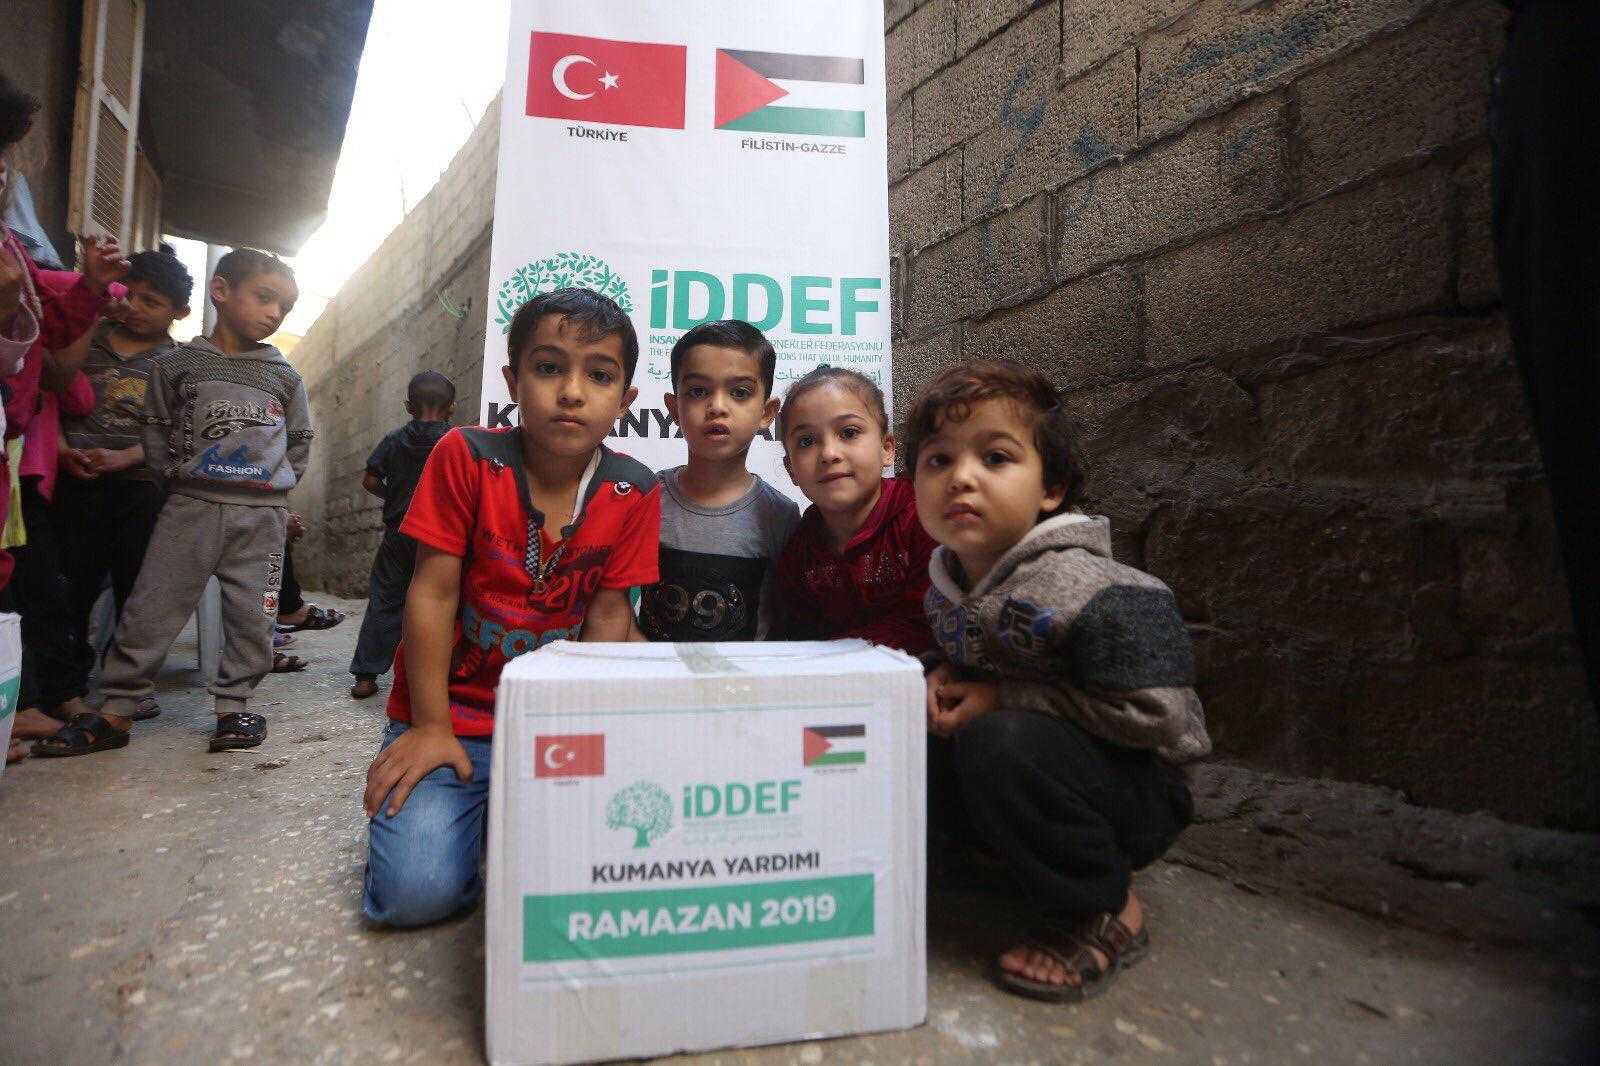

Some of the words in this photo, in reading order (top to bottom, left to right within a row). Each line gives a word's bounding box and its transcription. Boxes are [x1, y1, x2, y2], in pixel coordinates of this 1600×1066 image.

[566, 125, 628, 142] TÜRKİYE
[741, 138, 847, 155] FİLİSTİN-GAZZE
[843, 354, 883, 363] HUMANITY
[207, 463, 263, 476] FASHION
[591, 858, 717, 884] KUMANYA
[726, 851, 821, 876] YARDIMI
[567, 901, 753, 943] RAMAZAN
[760, 893, 837, 928] 2019
